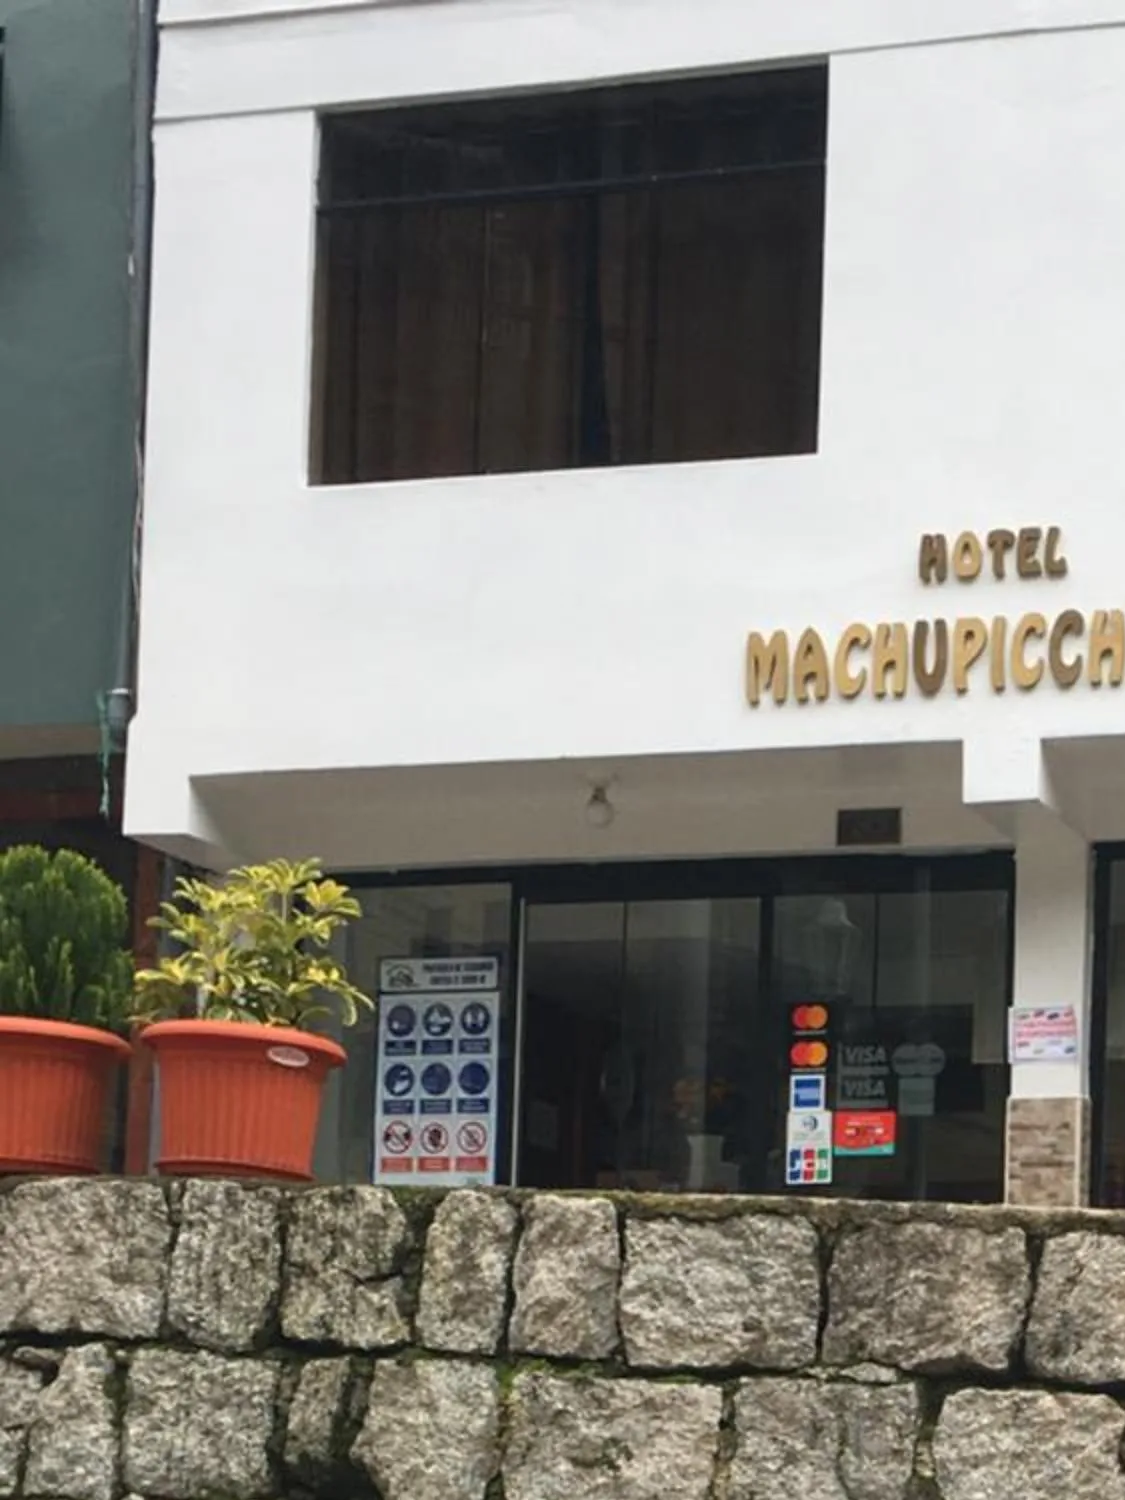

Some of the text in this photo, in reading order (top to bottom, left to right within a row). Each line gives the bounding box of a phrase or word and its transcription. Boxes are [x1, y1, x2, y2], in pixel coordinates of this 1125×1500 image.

[918, 526, 1069, 586] HOTEL
[844, 1045, 887, 1064] VISA
[843, 1079, 886, 1097] VISA
